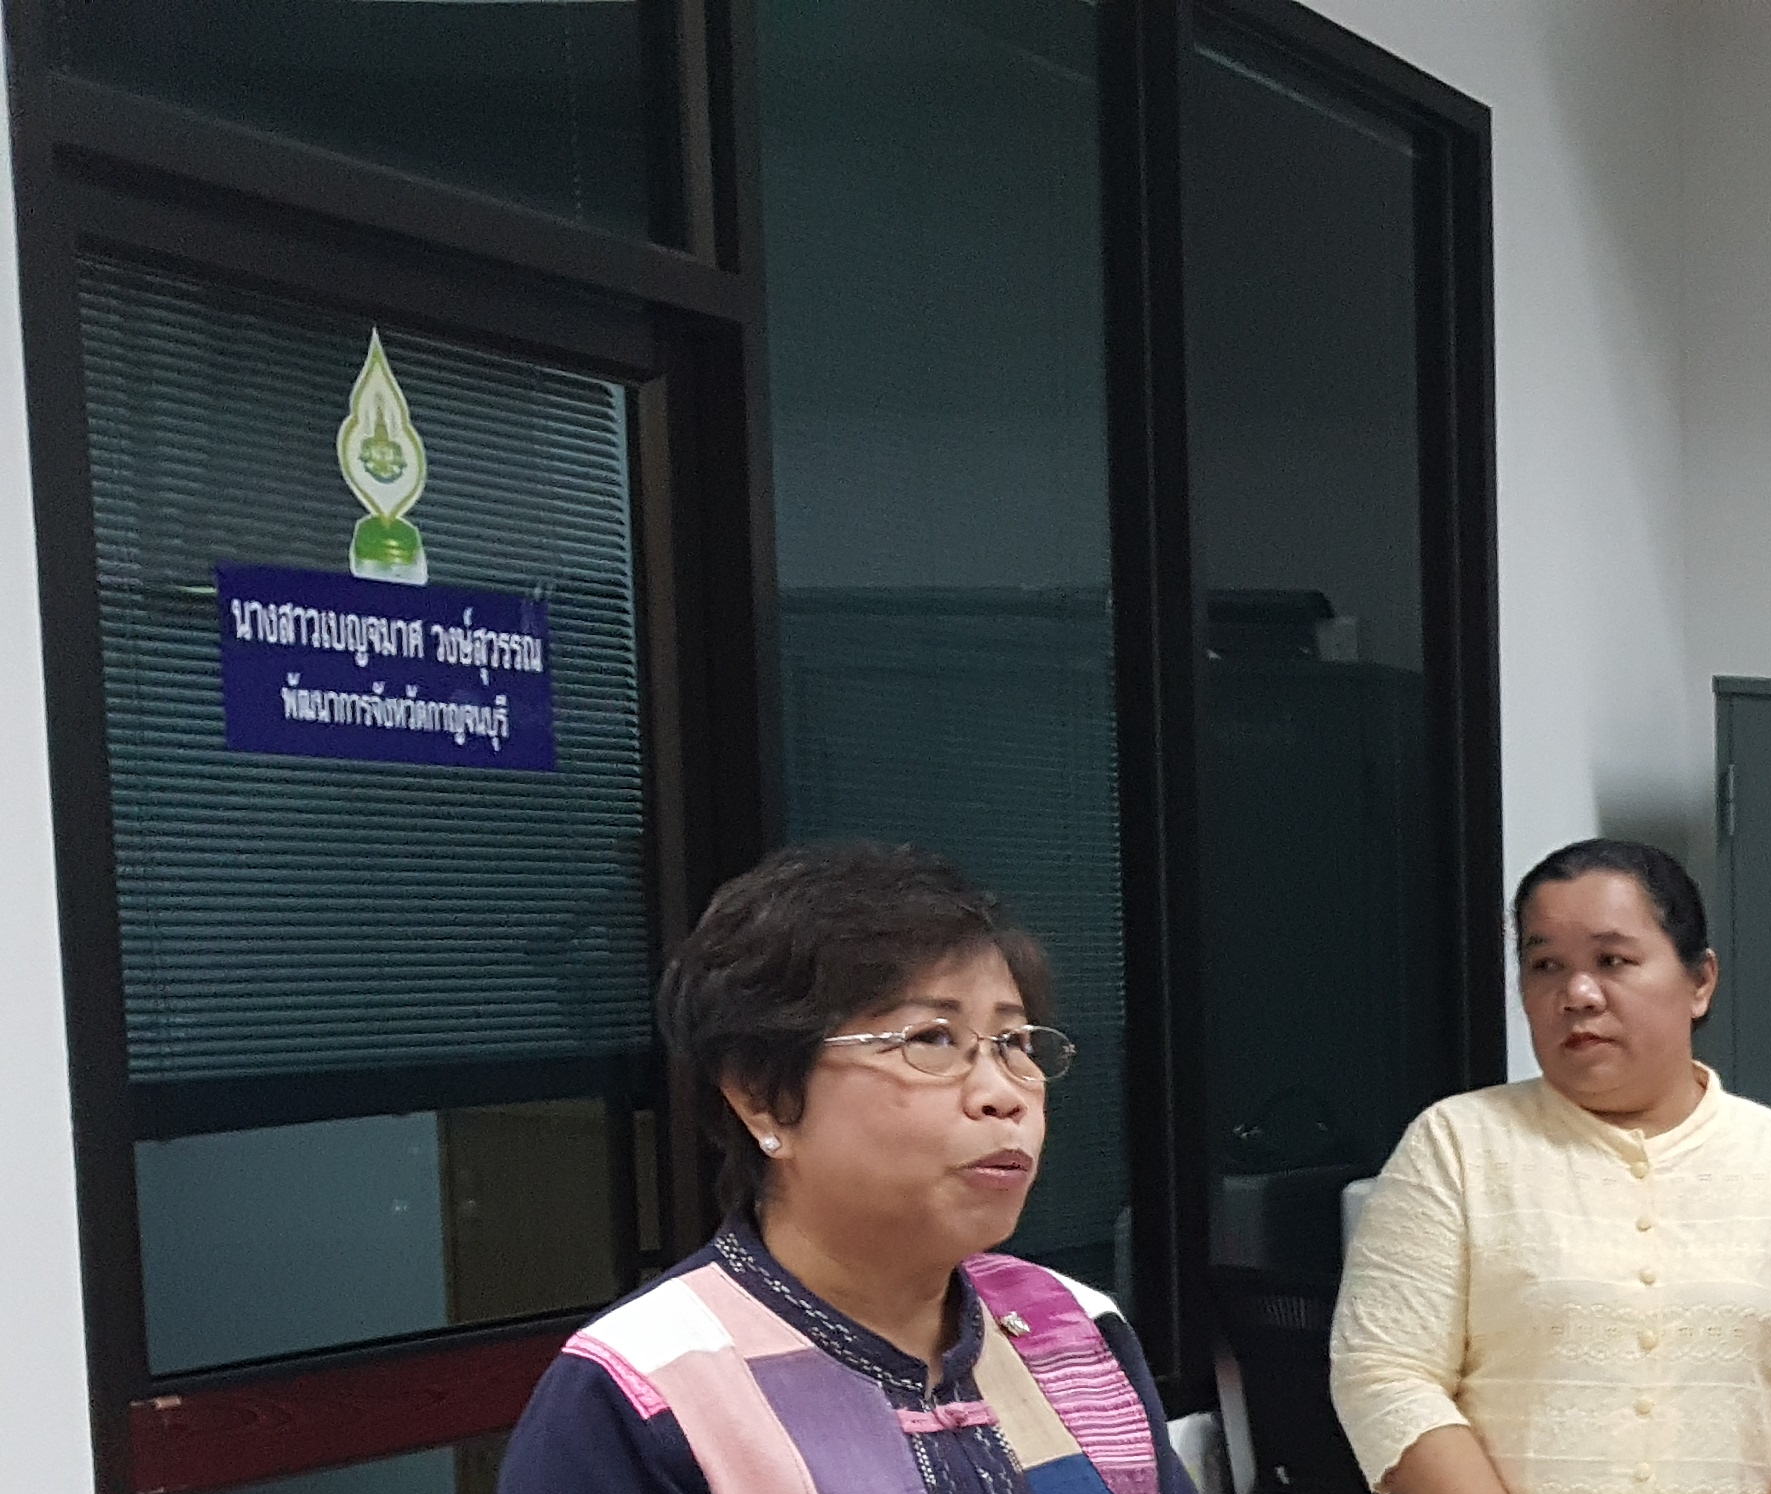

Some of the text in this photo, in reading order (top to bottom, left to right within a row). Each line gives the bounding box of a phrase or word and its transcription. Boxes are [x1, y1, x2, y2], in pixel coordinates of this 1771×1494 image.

[231, 599, 543, 685] นางสาวเบญจมาศ วงษ์สุวรรณ
[281, 672, 510, 751] พัฒนาการจังหวัดกาญจนบุรี
